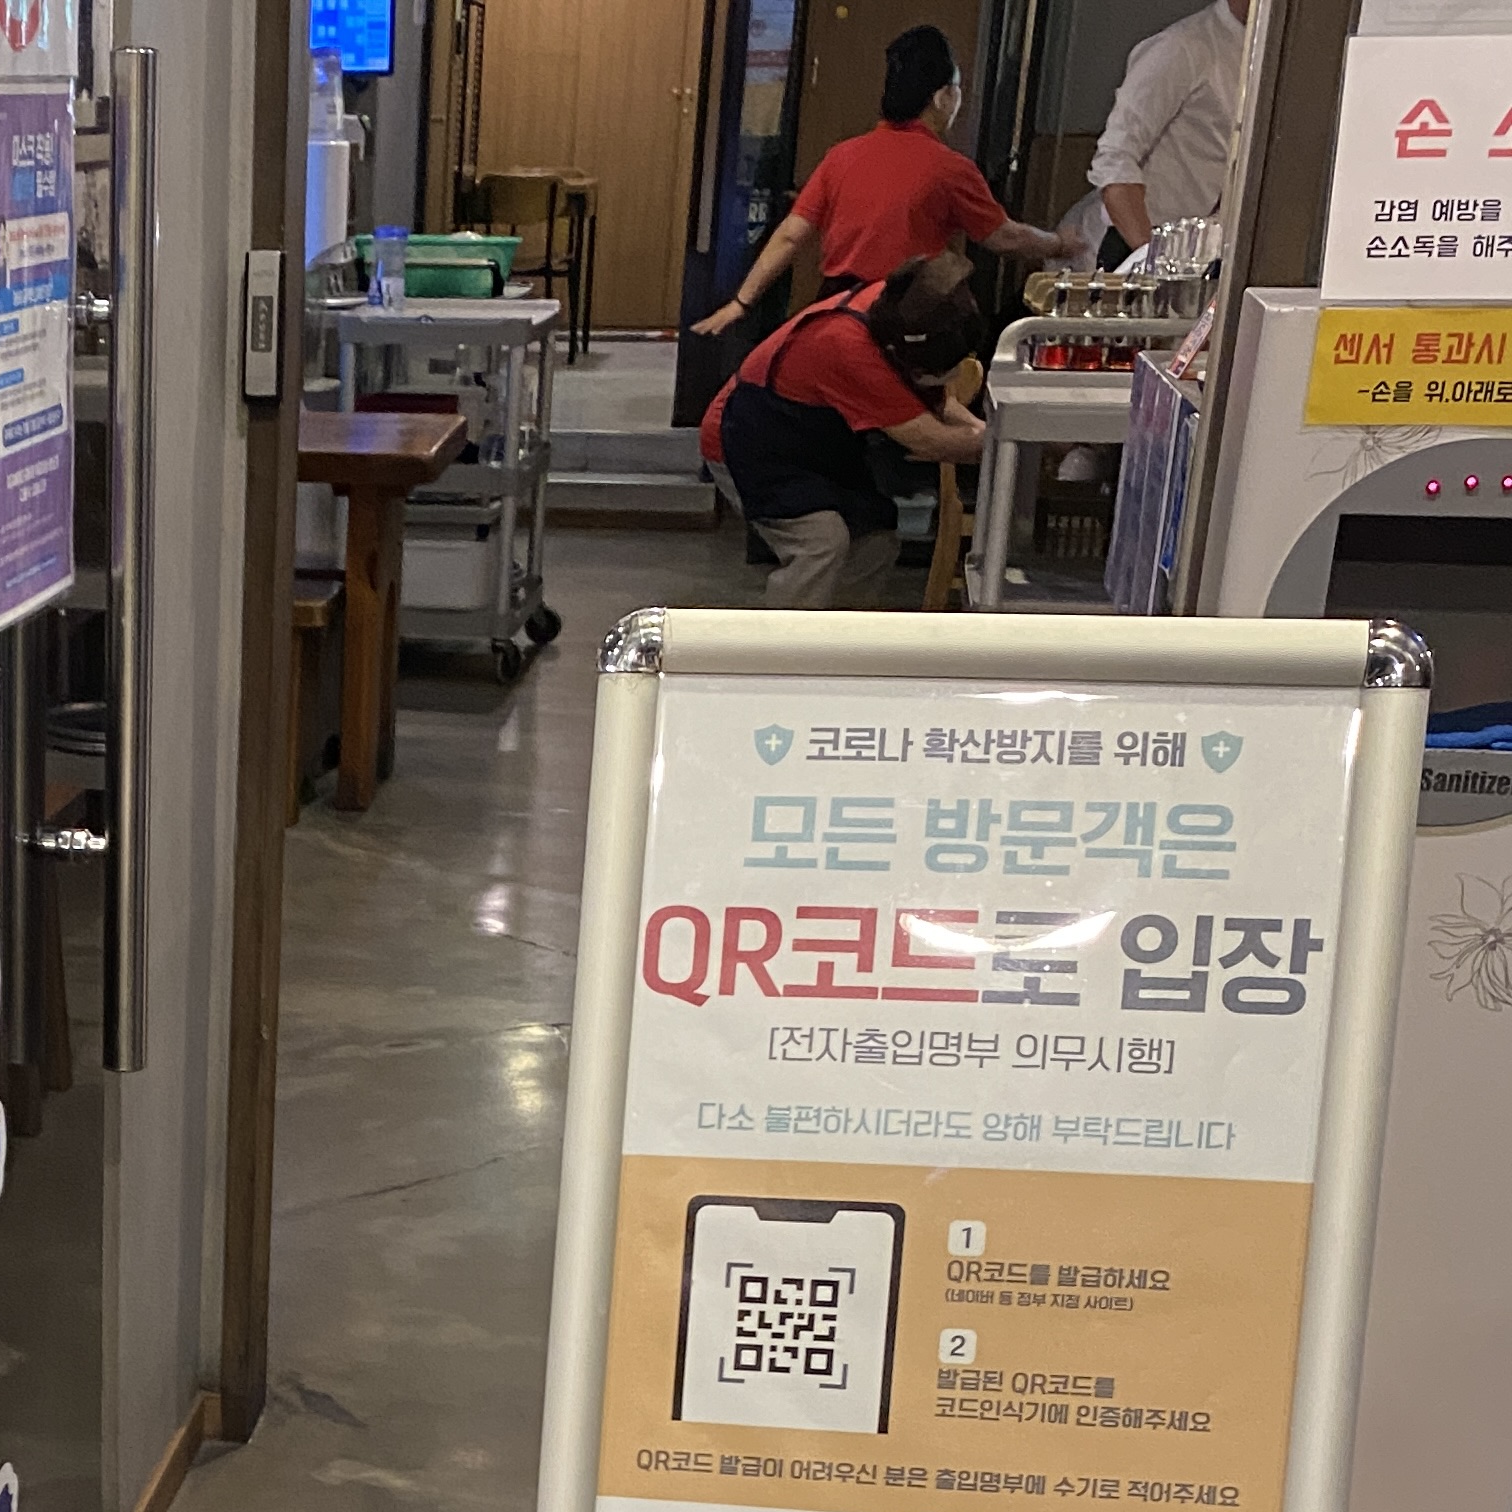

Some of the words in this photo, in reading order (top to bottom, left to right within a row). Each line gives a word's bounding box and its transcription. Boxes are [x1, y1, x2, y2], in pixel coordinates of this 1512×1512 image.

[1395, 99, 1452, 158] 손
[1374, 199, 1418, 222] 감염
[1432, 198, 1502, 222] 예방을
[1366, 234, 1458, 259] 손소독을
[1333, 332, 1395, 365] 센서
[1412, 331, 1511, 365] 통과시
[1358, 381, 1413, 403] -손을
[806, 727, 913, 763] 코로나
[923, 727, 1103, 766] 확산방지를
[1114, 731, 1187, 768] 위해
[743, 795, 897, 871] 모든
[924, 798, 1236, 879] 방문객은
[643, 905, 1080, 1008] QR코드로
[1120, 914, 1324, 1016] 입장
[768, 1026, 1000, 1069] [전자출입명부
[1011, 1033, 1175, 1074] 의무시행]
[697, 1101, 754, 1131] 다소
[765, 1104, 973, 1140] 불편하시더라도
[982, 1112, 1042, 1142] 양해
[1052, 1115, 1236, 1149] 부탁드립니다
[961, 1226, 973, 1249] 1
[946, 1259, 1050, 1286] QR코드를
[1057, 1263, 1171, 1291] 발급하세요
[945, 1288, 994, 1304] (네이버
[999, 1291, 1012, 1306] 등
[1017, 1291, 1046, 1308] 정부
[1051, 1294, 1080, 1310] 지정
[1084, 1296, 1134, 1312] 사이트)
[950, 1334, 966, 1357] 2
[937, 1368, 1003, 1393] 발급된
[1011, 1371, 1115, 1399] QR코드를
[934, 1396, 1068, 1425] 코드인식기에
[1076, 1405, 1211, 1433] 인증해주세요
[637, 1449, 713, 1472] QR코드
[719, 1454, 783, 1479] 발급이
[790, 1459, 877, 1485] 어려우신
[884, 1465, 928, 1489] 분은
[935, 1468, 1045, 1496] 출입명부에
[1053, 1476, 1120, 1500] 수기로
[1127, 1480, 1240, 1508] 적어주세요
